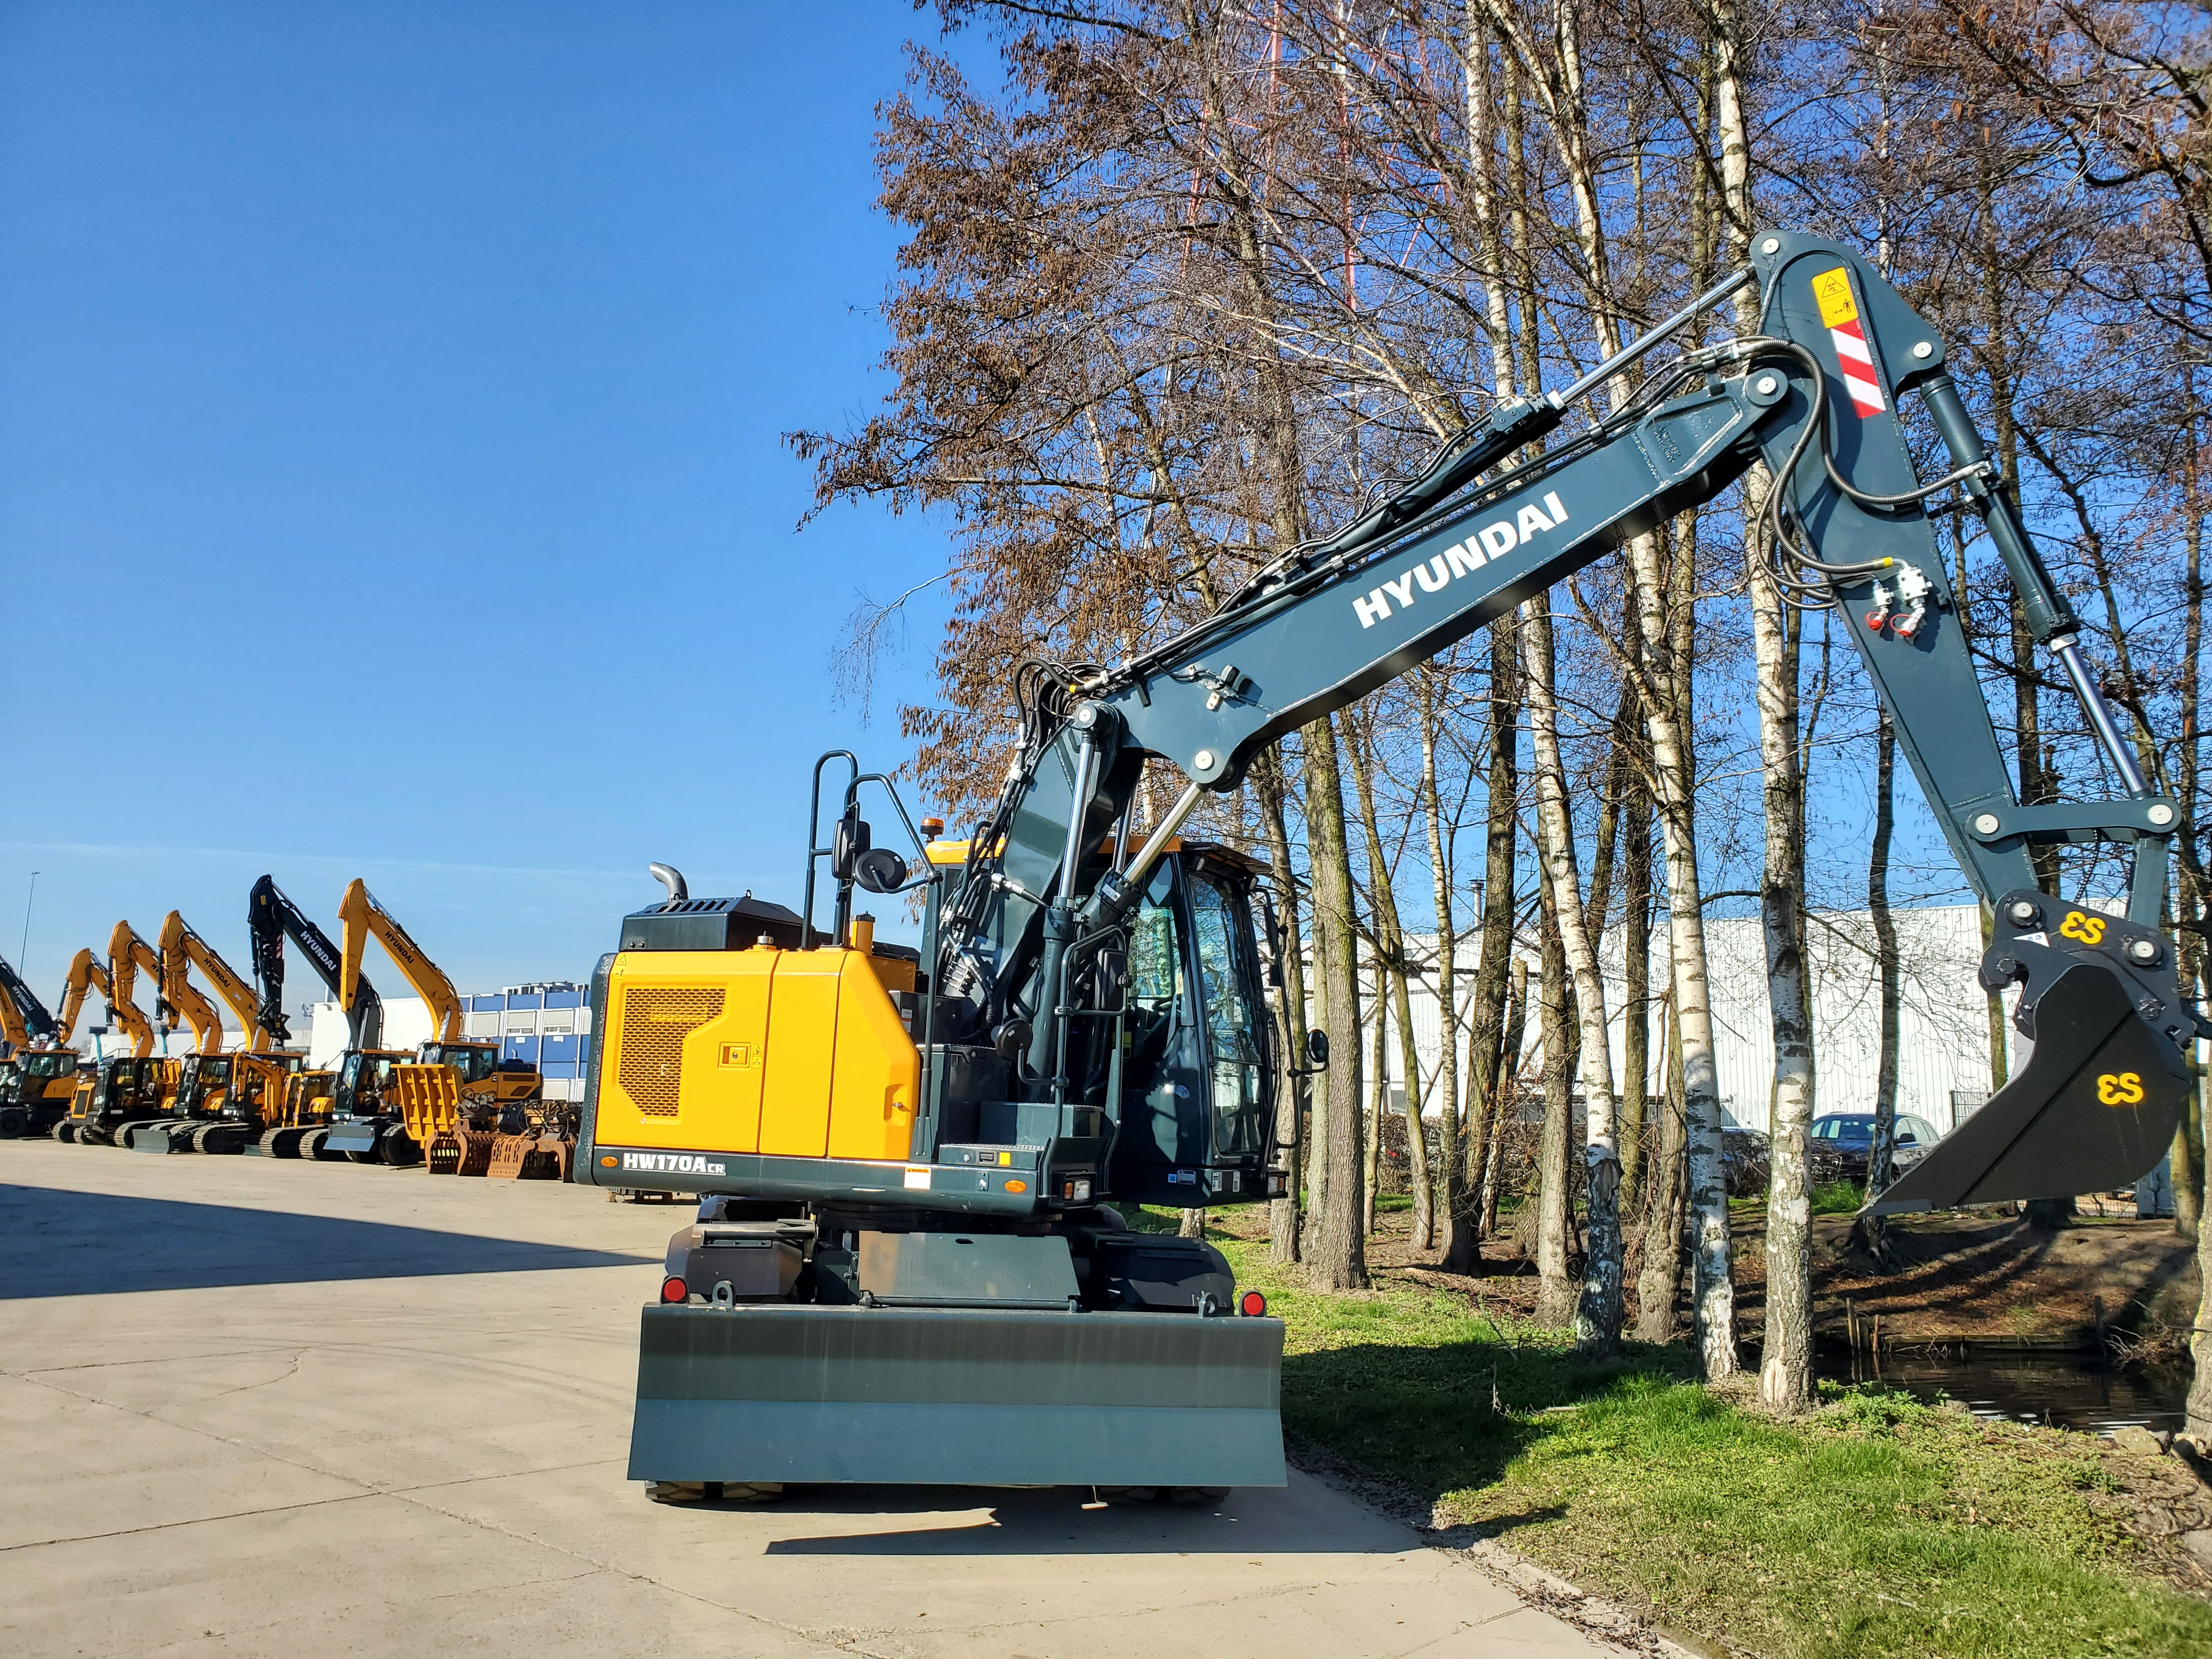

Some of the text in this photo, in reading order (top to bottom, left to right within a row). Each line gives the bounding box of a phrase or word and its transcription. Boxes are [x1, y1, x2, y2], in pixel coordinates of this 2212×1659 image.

[1352, 491, 1570, 629] HYUNDAI
[300, 930, 337, 971] HYUNDAI
[385, 931, 415, 964] HYUNDAI
[204, 958, 230, 988] HYUNDAI
[12, 986, 34, 1012] HYUNDAI
